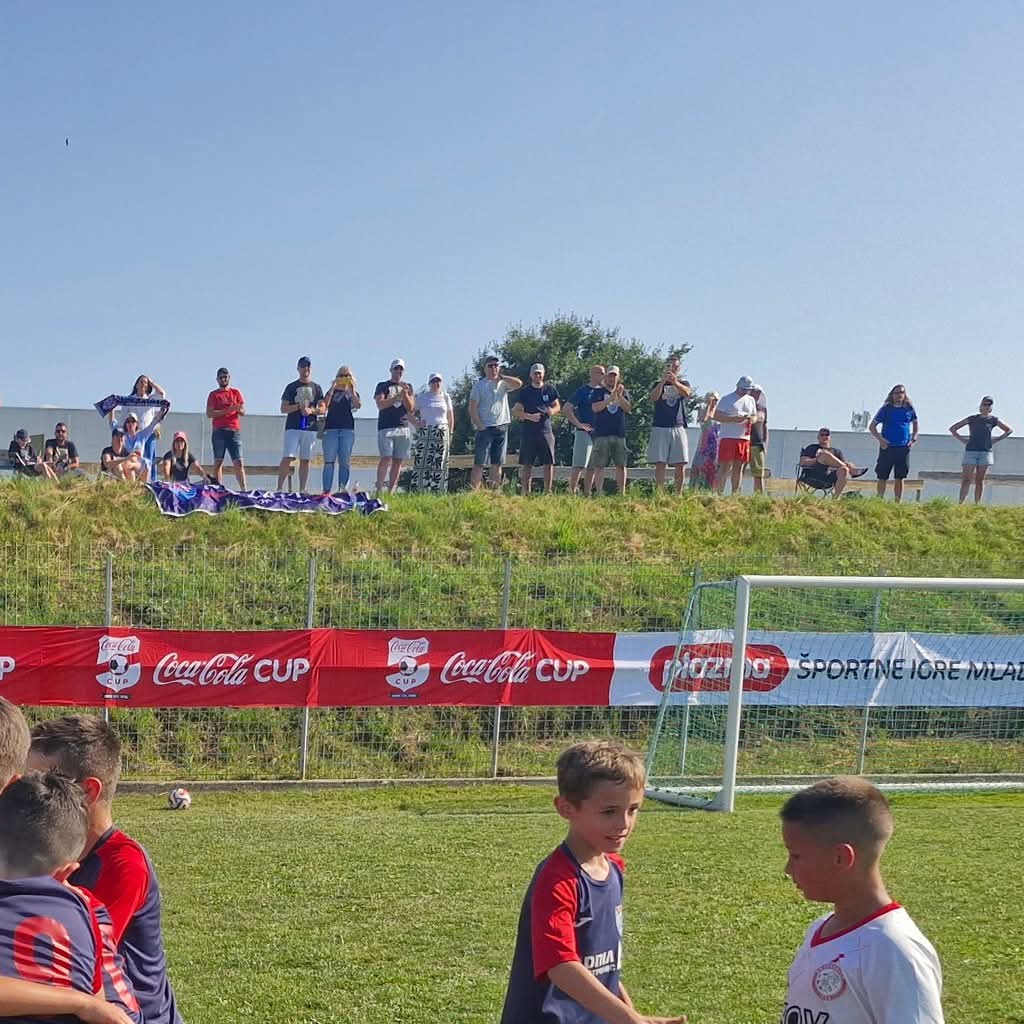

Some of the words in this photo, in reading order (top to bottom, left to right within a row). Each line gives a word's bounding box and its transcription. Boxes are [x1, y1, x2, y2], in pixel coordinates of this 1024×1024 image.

[106, 677, 129, 685] CUP
[152, 652, 255, 686] Coca-Cola
[253, 658, 311, 682] CUP
[440, 651, 536, 684] Coca-Cola
[535, 658, 590, 682] CUP
[797, 652, 905, 680] ŠPORTNE
[910, 659, 961, 680] IGRE
